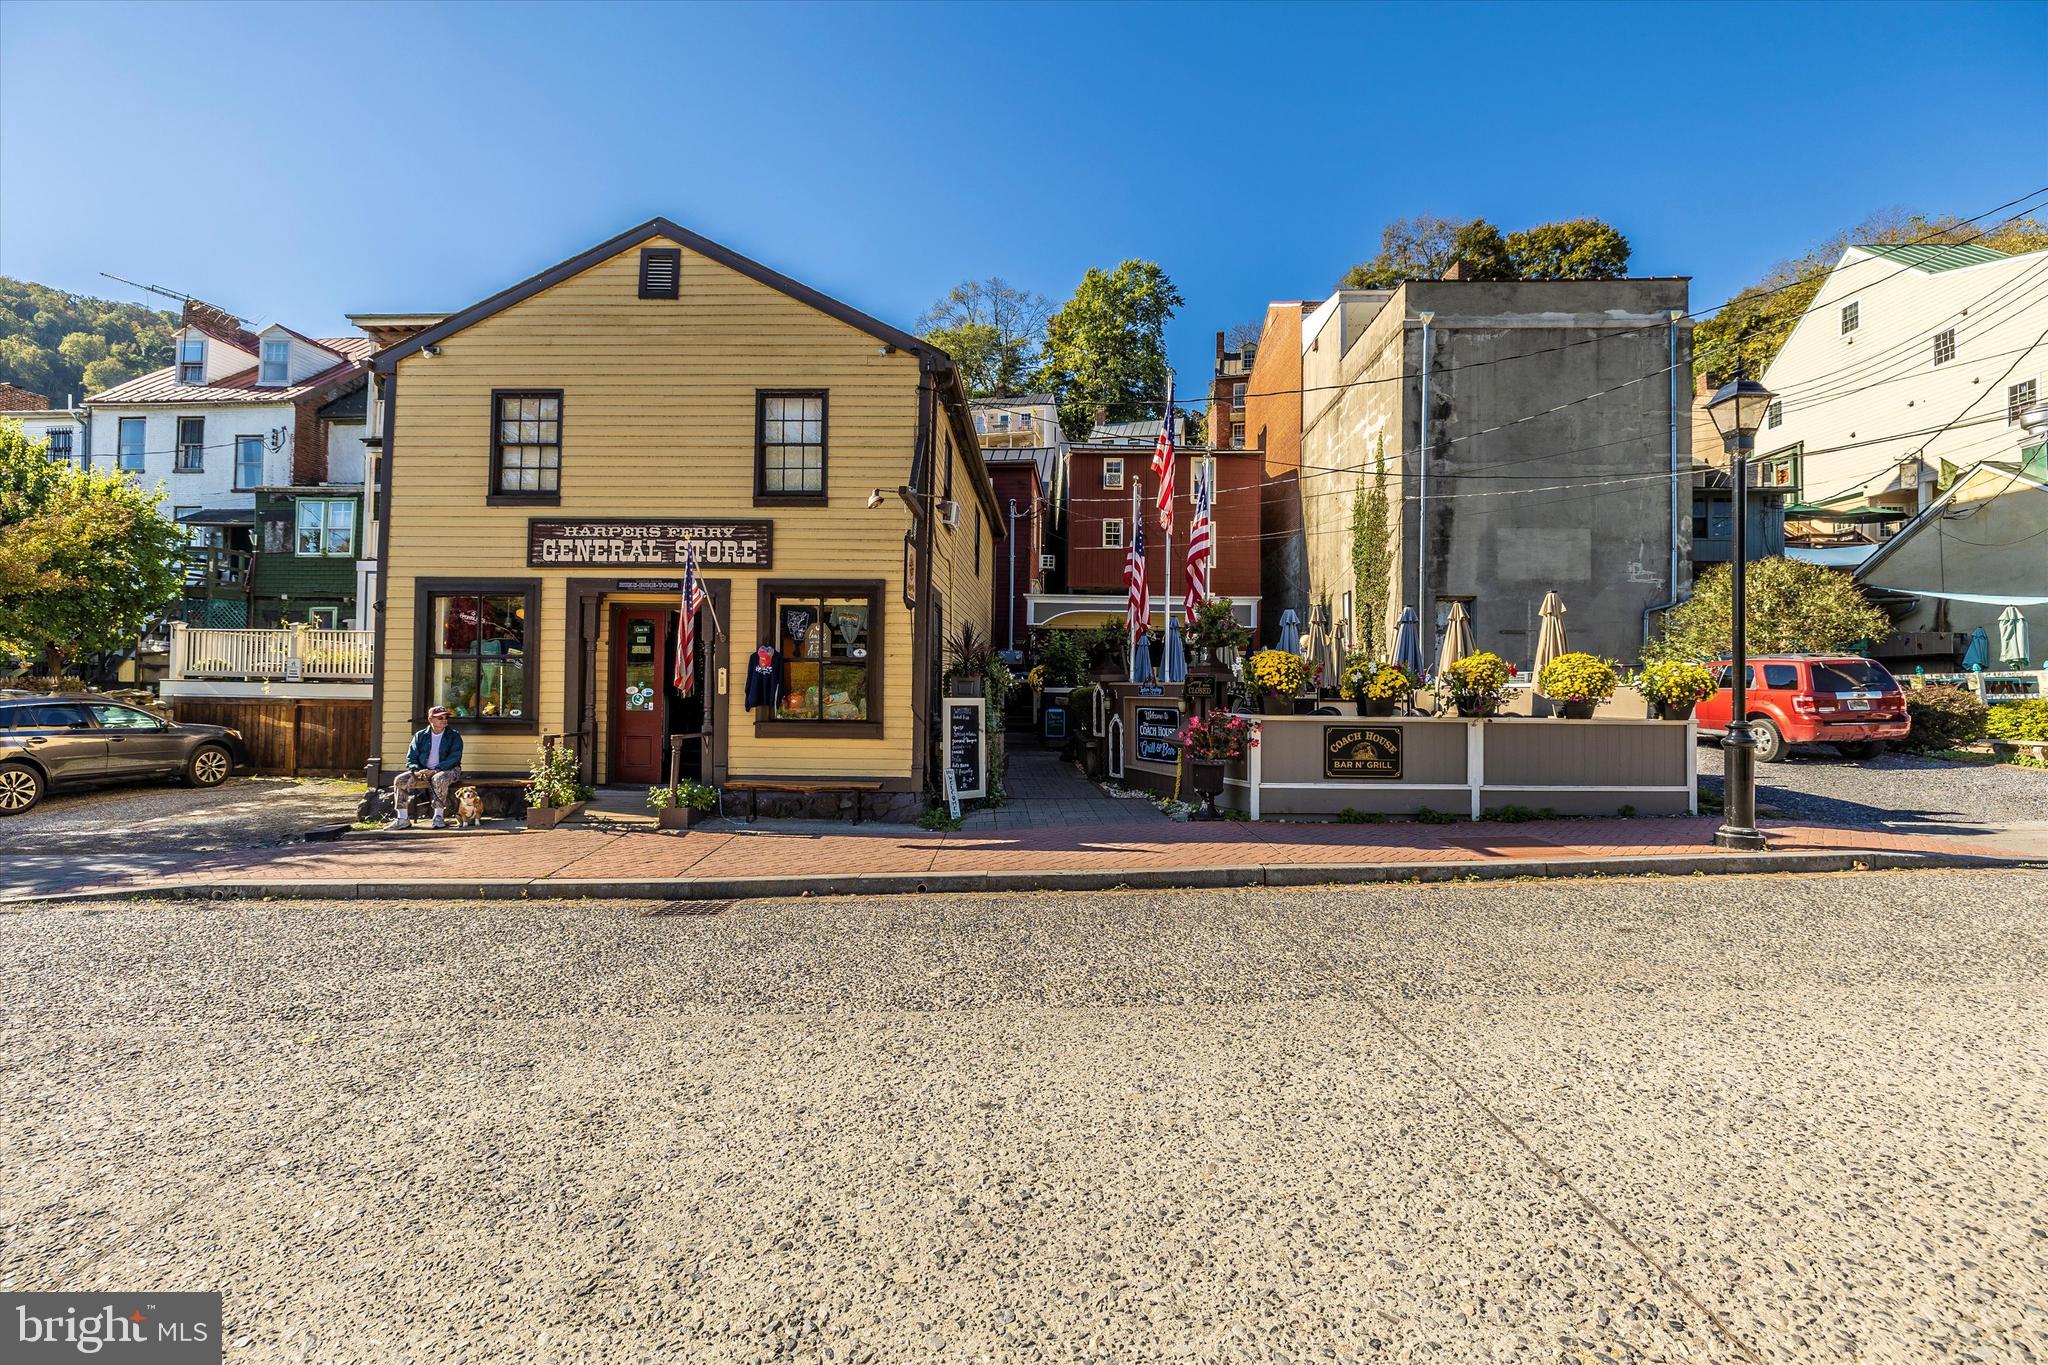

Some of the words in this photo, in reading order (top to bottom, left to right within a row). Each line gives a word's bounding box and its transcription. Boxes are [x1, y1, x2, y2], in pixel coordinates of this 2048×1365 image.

[564, 526, 661, 537] HARPERS
[667, 527, 736, 538] FERRY
[542, 539, 662, 563] GENERAL
[674, 540, 757, 563] STORE
[1140, 725, 1157, 736] COACH
[1140, 740, 1156, 756] Grill
[1162, 742, 1176, 757] Bar
[1330, 732, 1362, 753] COACH
[1365, 731, 1398, 754] HOUSE
[1334, 761, 1353, 769] BAR
[1355, 761, 1364, 769] N'
[1366, 761, 1392, 769] GRILL
